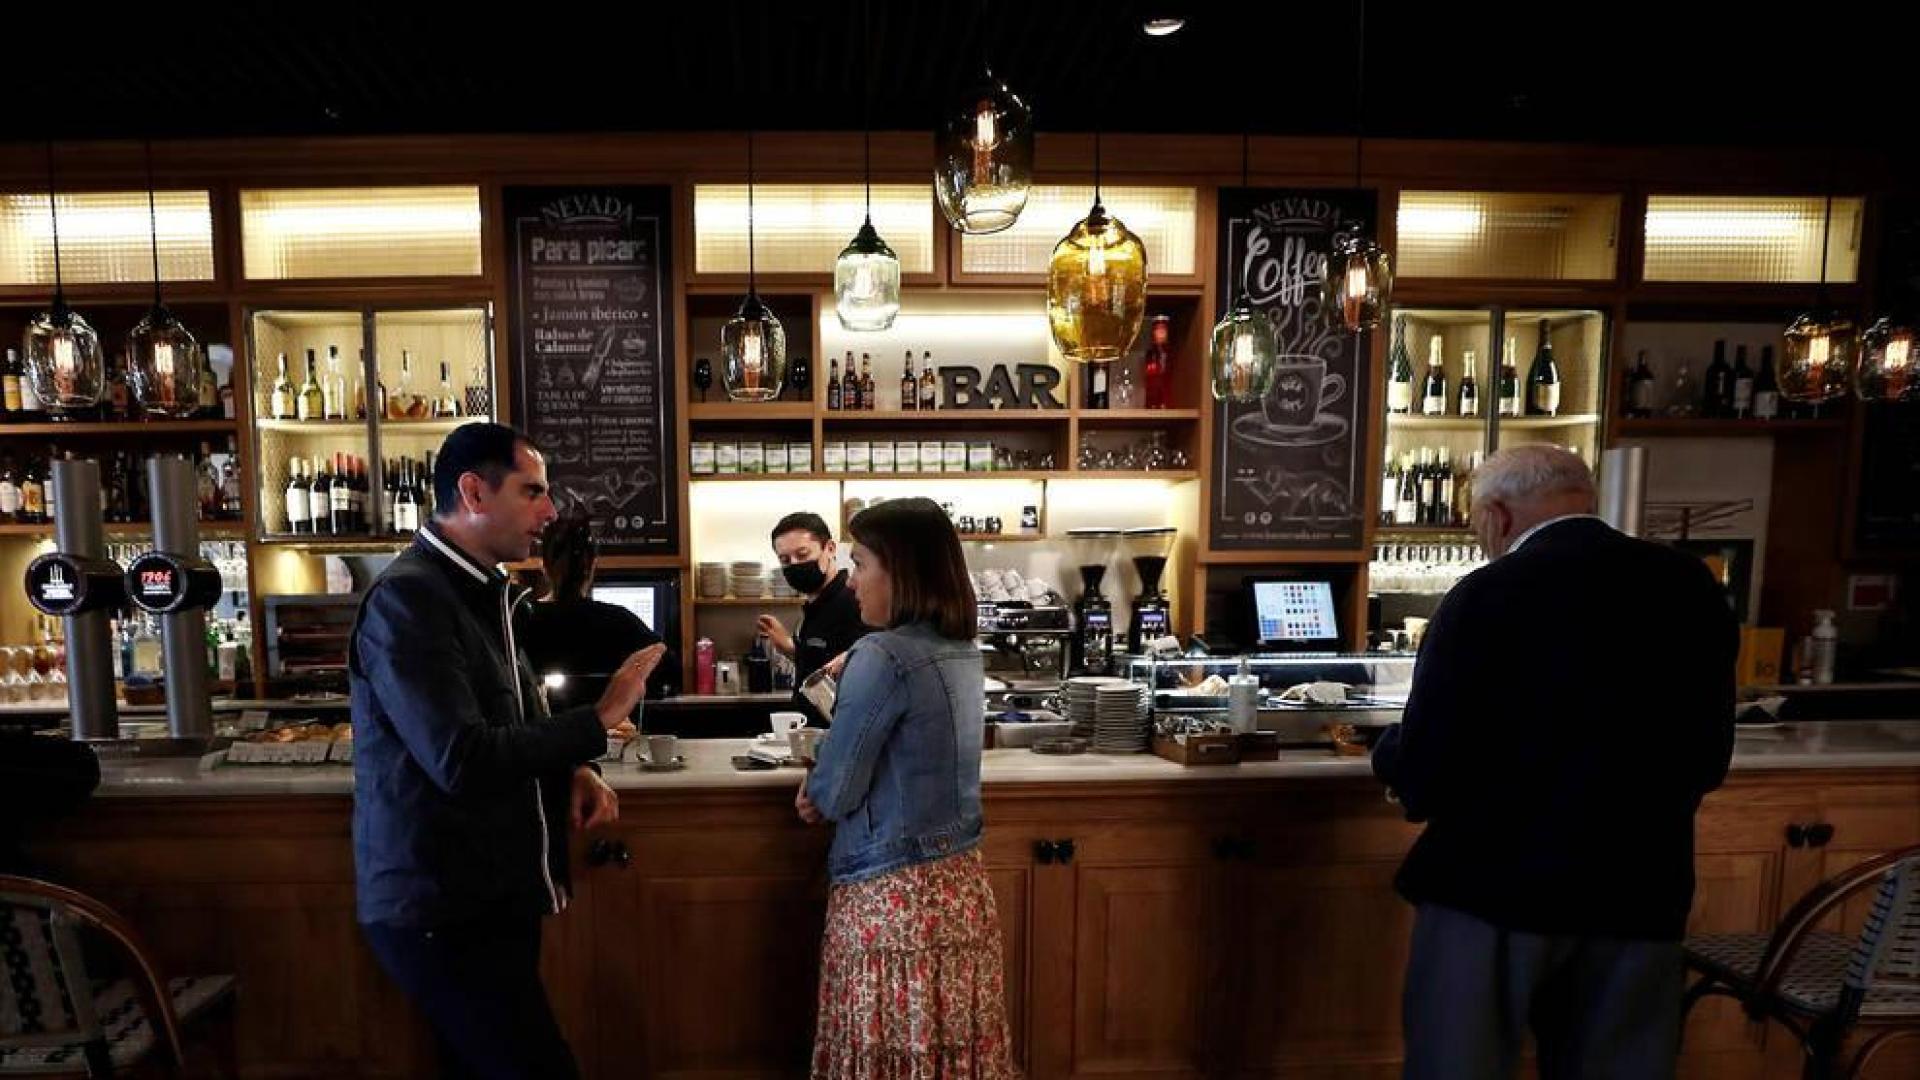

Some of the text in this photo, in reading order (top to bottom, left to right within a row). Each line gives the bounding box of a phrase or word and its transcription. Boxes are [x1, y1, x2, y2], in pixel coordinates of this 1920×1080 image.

[541, 193, 634, 229] NEVADA
[531, 237, 581, 263] Para
[939, 364, 1065, 410] BAR
